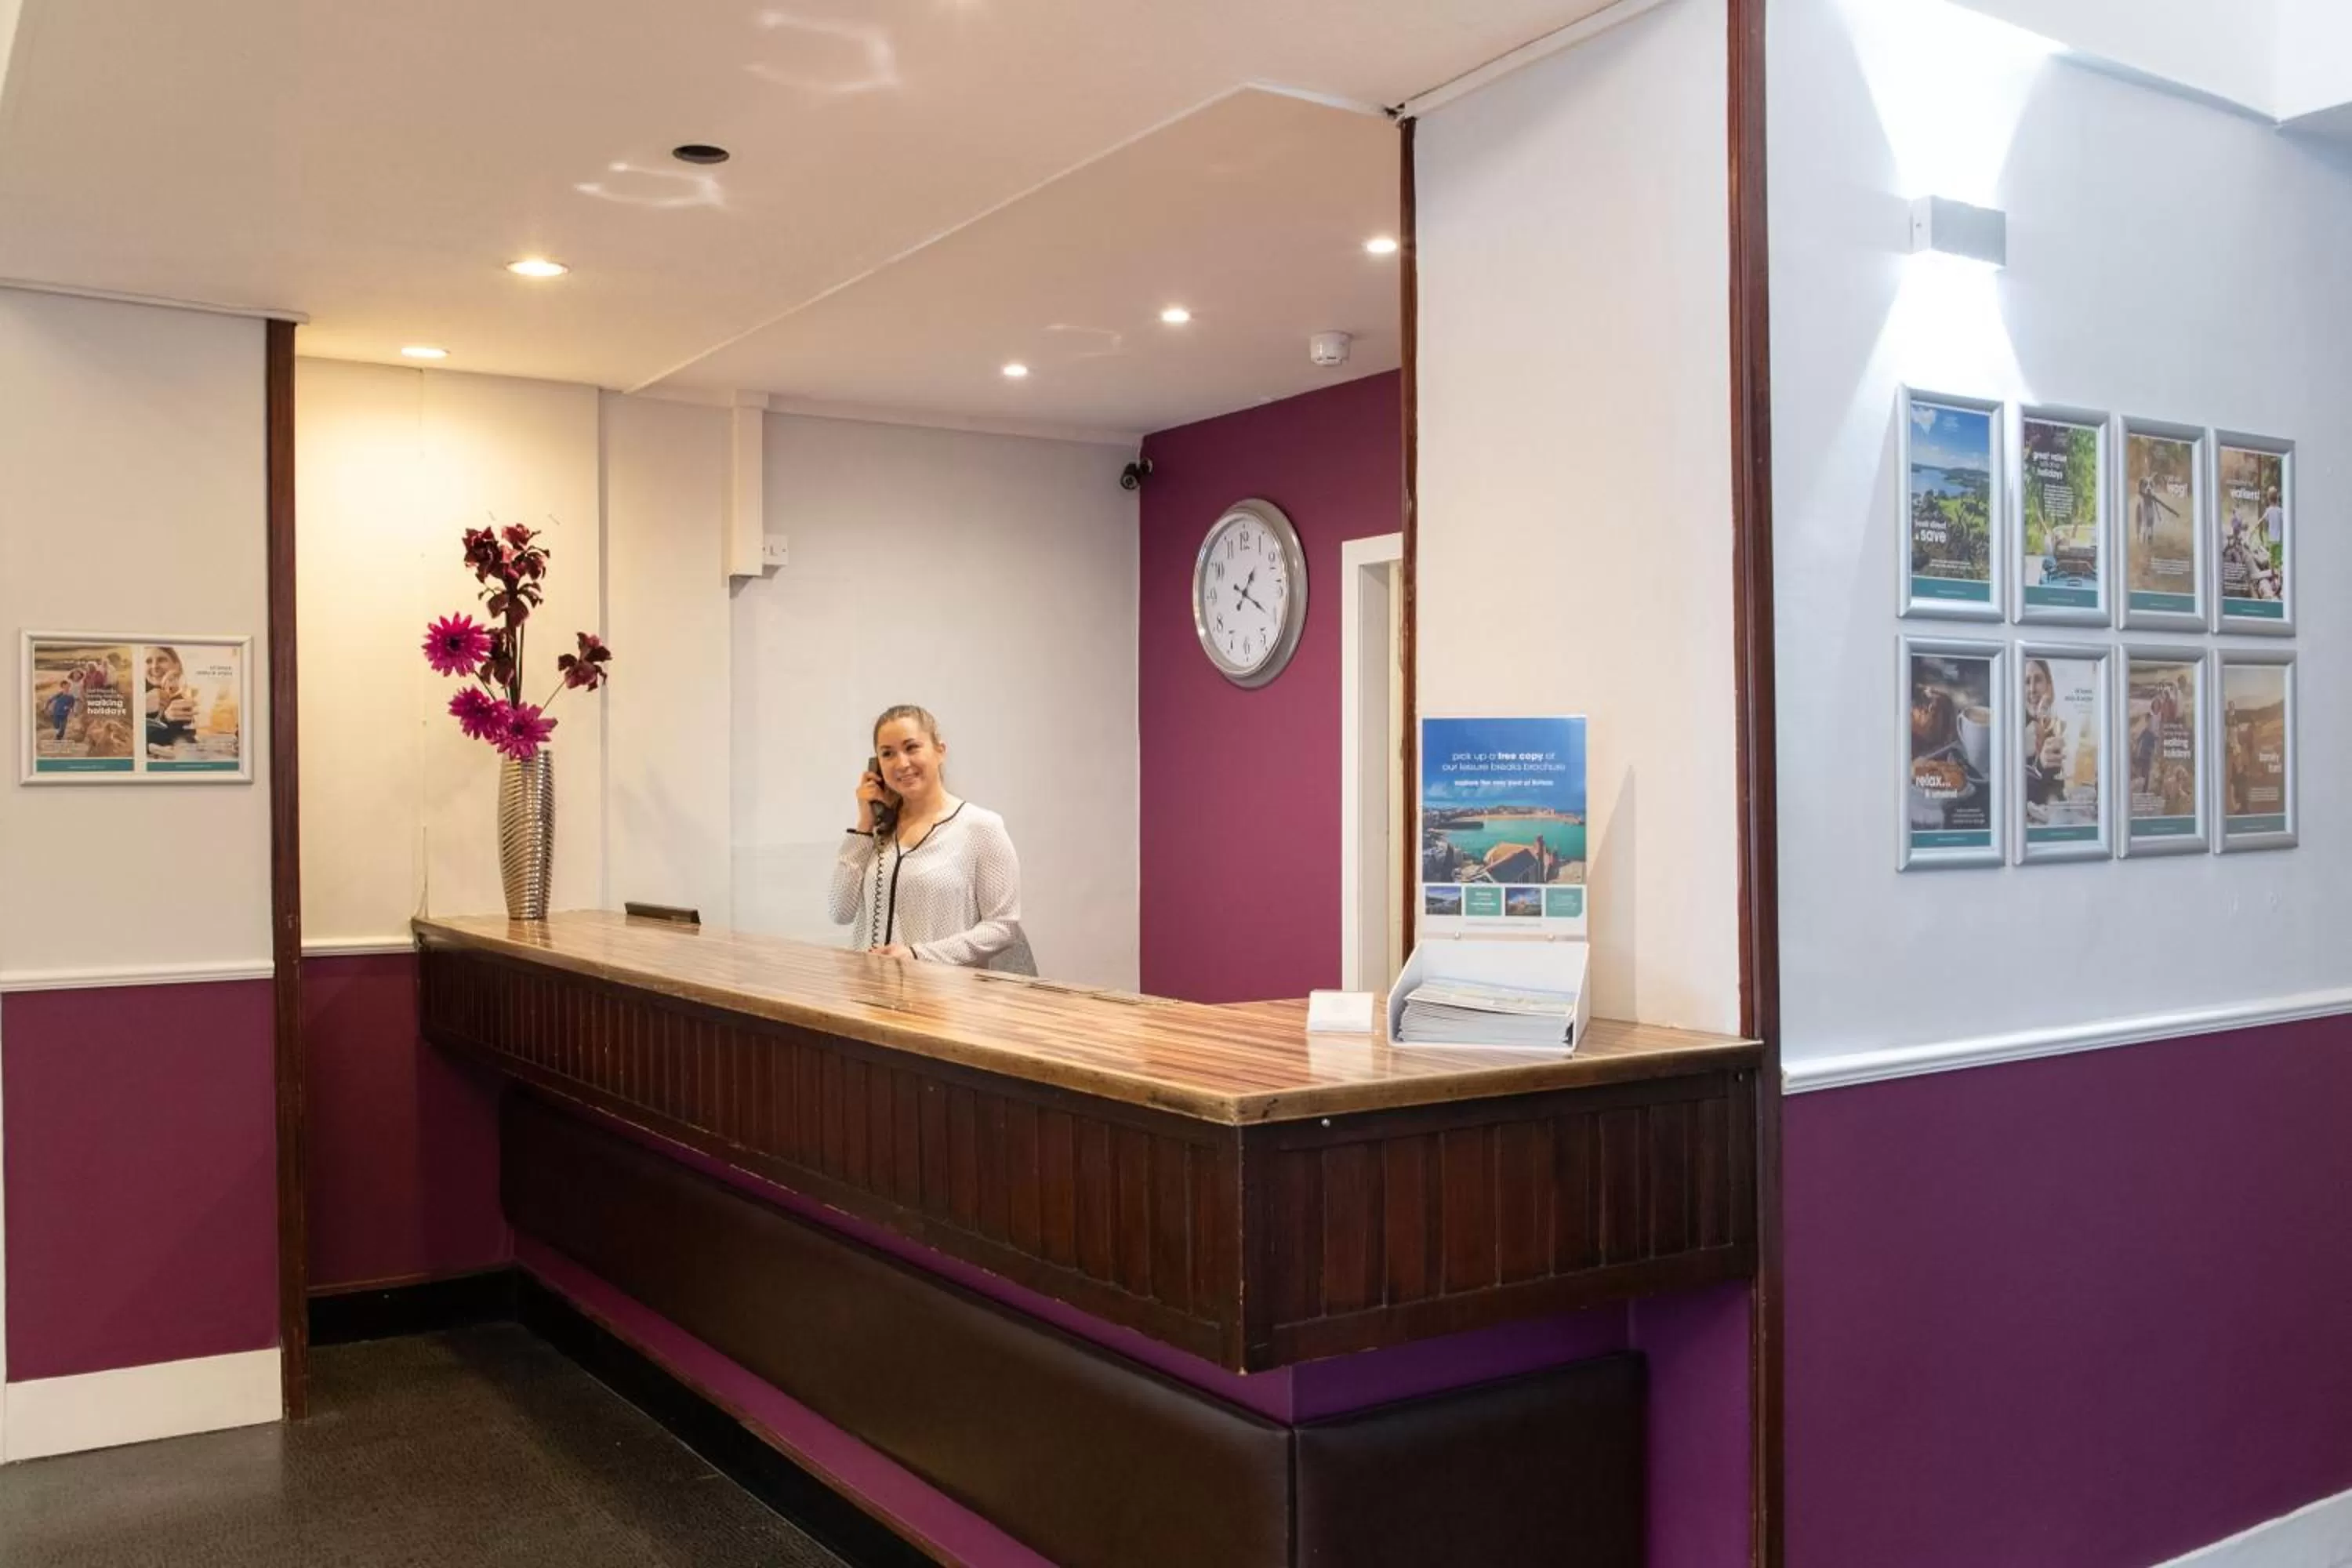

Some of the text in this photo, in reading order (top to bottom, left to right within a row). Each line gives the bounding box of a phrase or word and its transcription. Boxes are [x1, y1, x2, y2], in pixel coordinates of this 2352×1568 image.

[1921, 529, 1947, 544] save
[87, 699, 124, 708] walking
[87, 706, 126, 716] holidays
[1452, 751, 1472, 761] pick
[1474, 753, 1487, 761] up
[1497, 751, 1517, 760] free
[1519, 753, 1544, 763] copy
[1545, 752, 1556, 760] of
